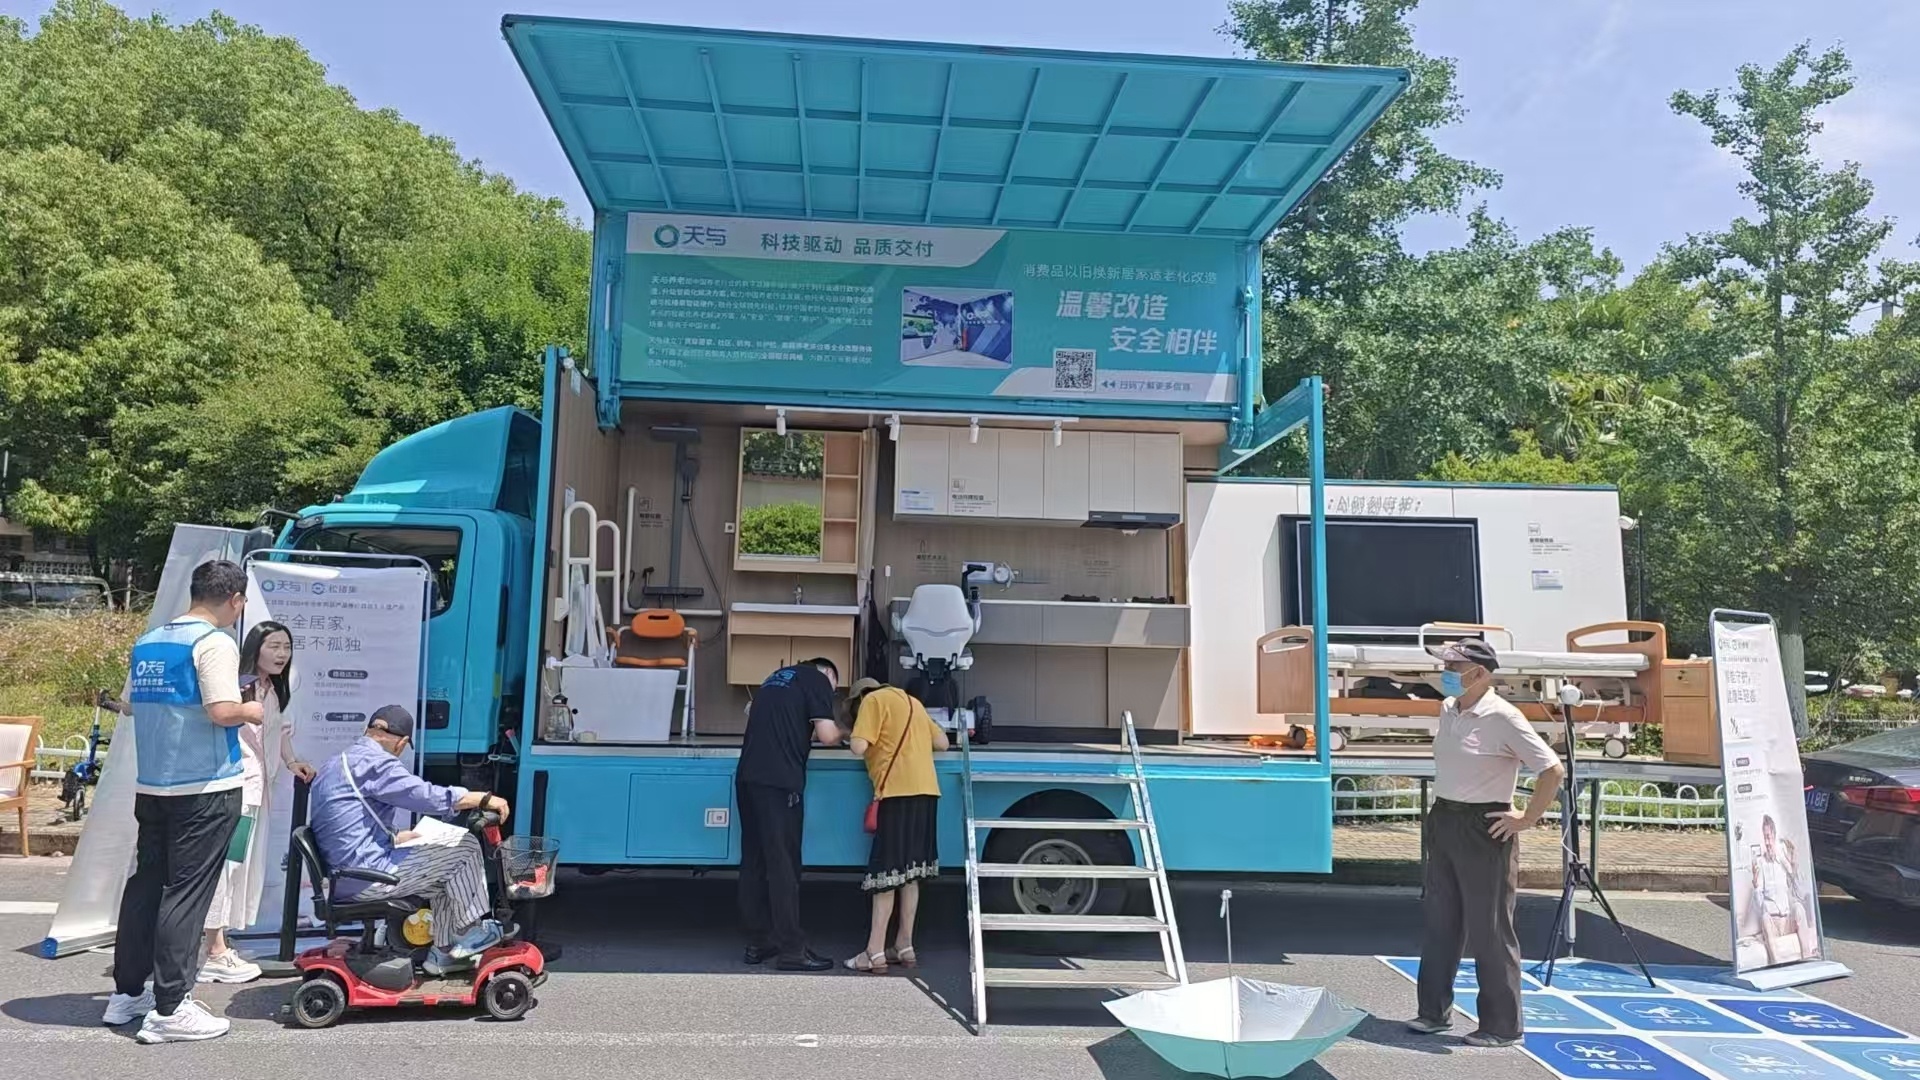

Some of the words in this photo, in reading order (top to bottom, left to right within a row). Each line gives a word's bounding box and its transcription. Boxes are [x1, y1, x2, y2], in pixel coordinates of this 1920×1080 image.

[682, 225, 727, 247] 天与
[760, 232, 843, 255] 科技驱动
[853, 237, 934, 258] 品质交付
[1056, 290, 1169, 321] 温馨改造
[1109, 326, 1218, 356] 安全相伴
[293, 635, 362, 653] 居不孤独
